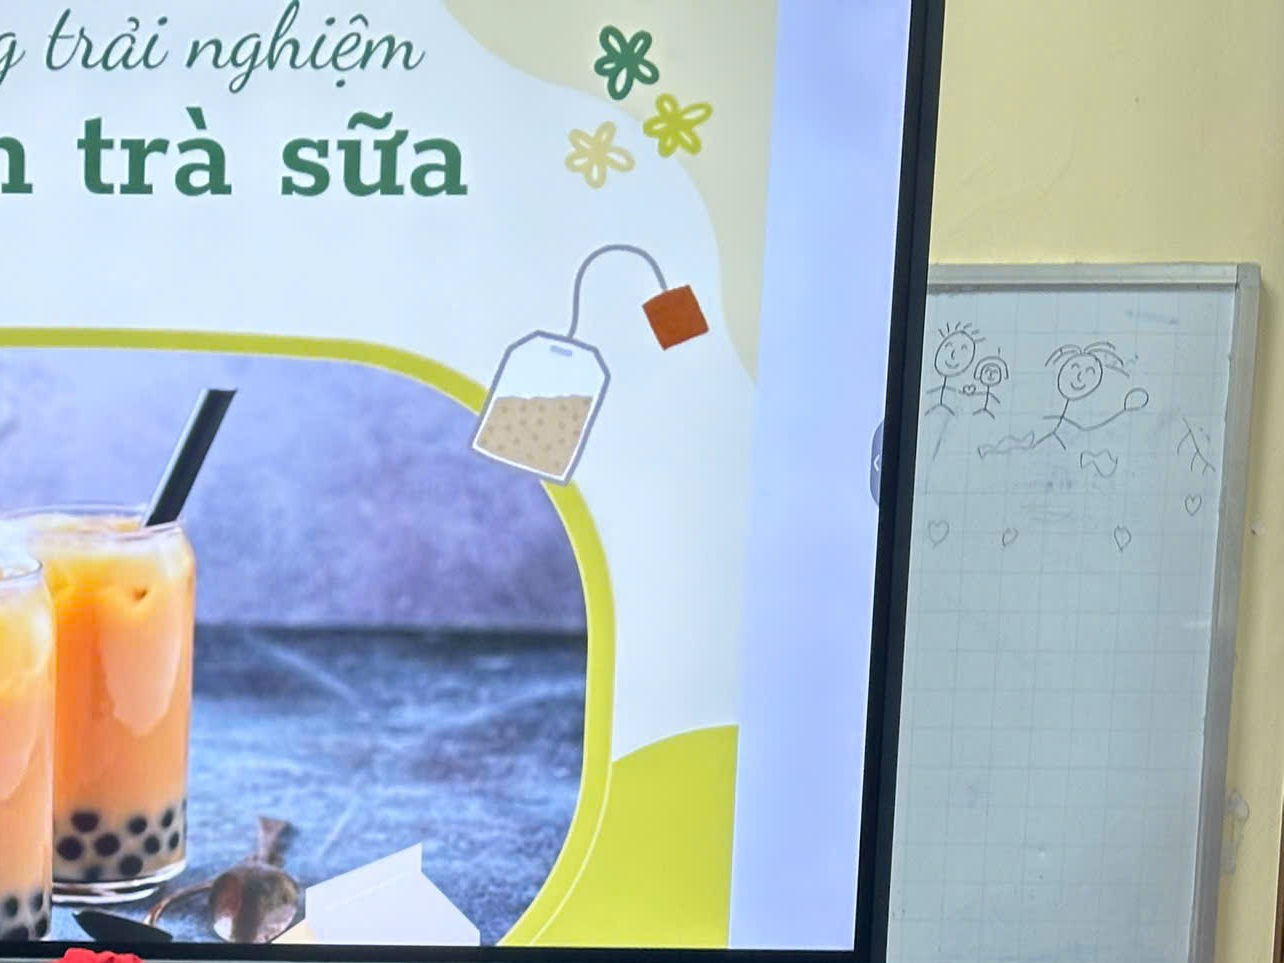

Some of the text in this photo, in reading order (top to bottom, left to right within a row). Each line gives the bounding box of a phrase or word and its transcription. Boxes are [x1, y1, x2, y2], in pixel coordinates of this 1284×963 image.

[45, 8, 168, 72] trải
[186, 0, 425, 93] nghiệm
[77, 106, 232, 197] trà
[281, 111, 468, 197] sữa
